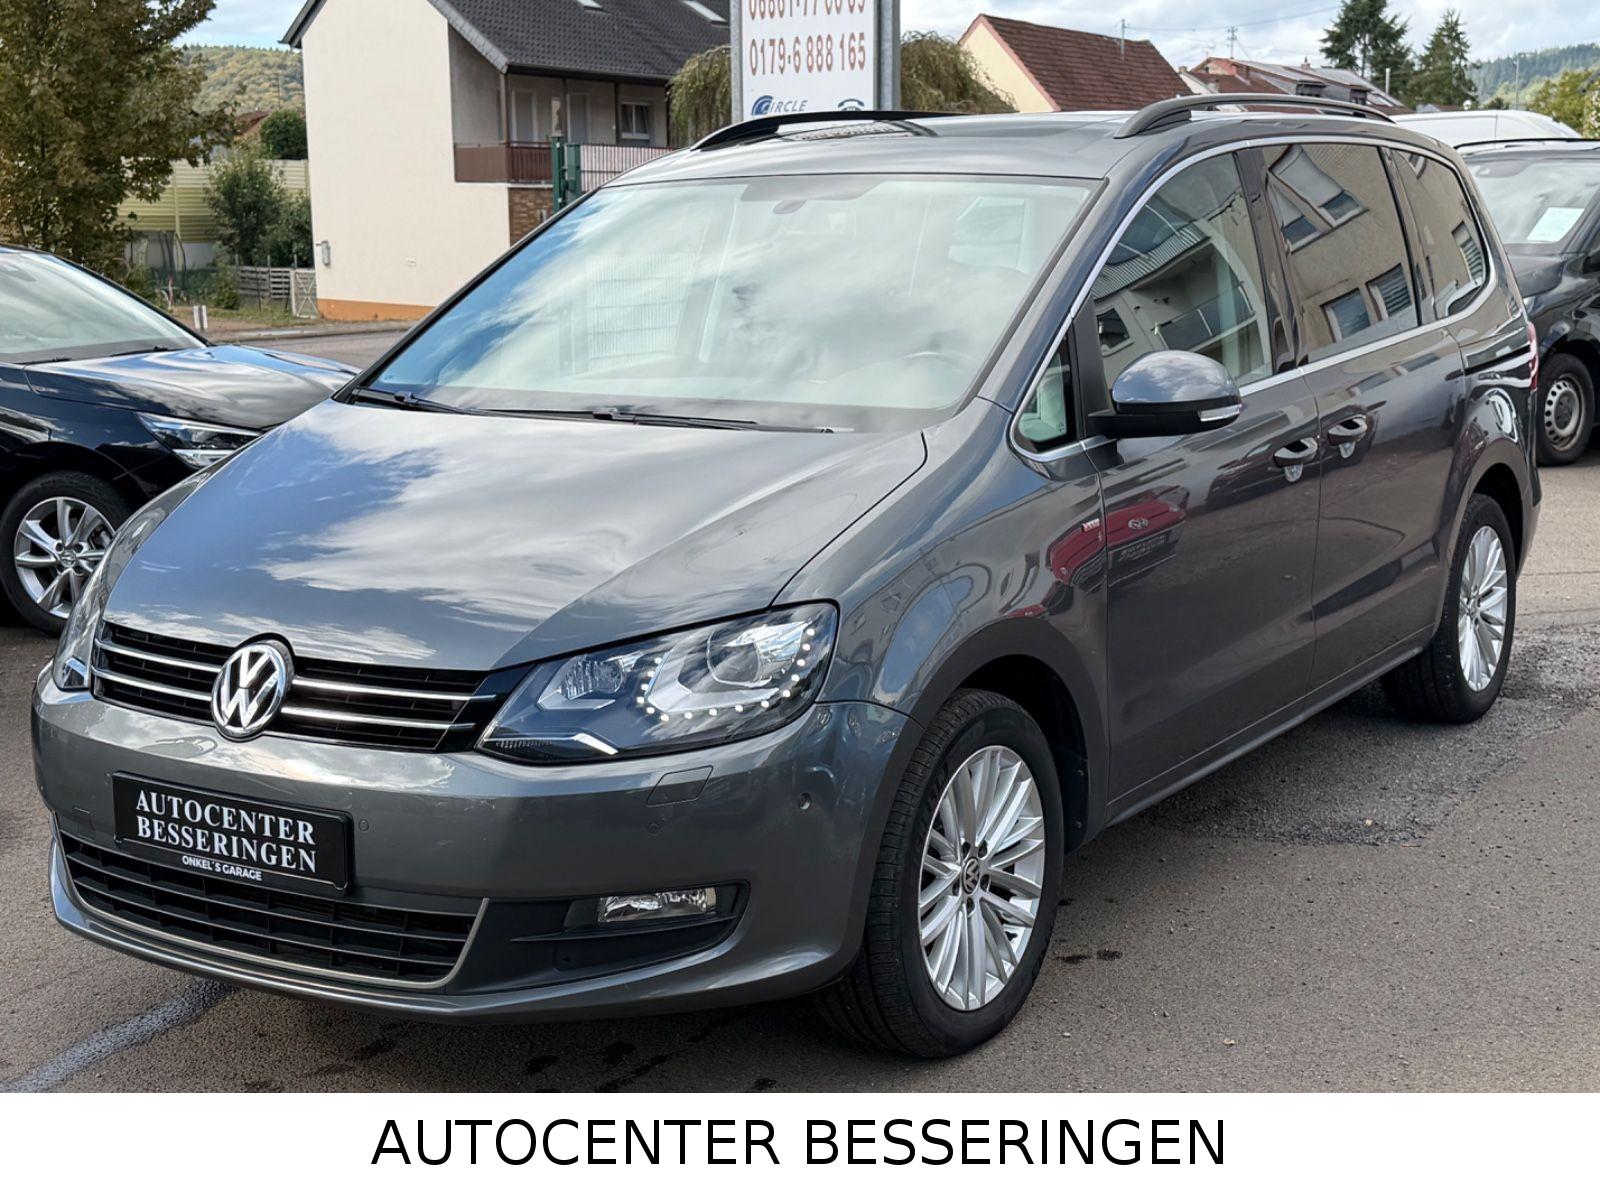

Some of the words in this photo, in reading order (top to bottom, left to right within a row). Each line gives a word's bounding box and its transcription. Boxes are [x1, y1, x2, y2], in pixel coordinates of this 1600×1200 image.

[806, 34, 833, 73] 888
[839, 32, 866, 71] 165
[136, 789, 316, 846] AUTOCENTER
[136, 815, 317, 873] BESSERINGEN
[222, 864, 263, 881] GARAGE
